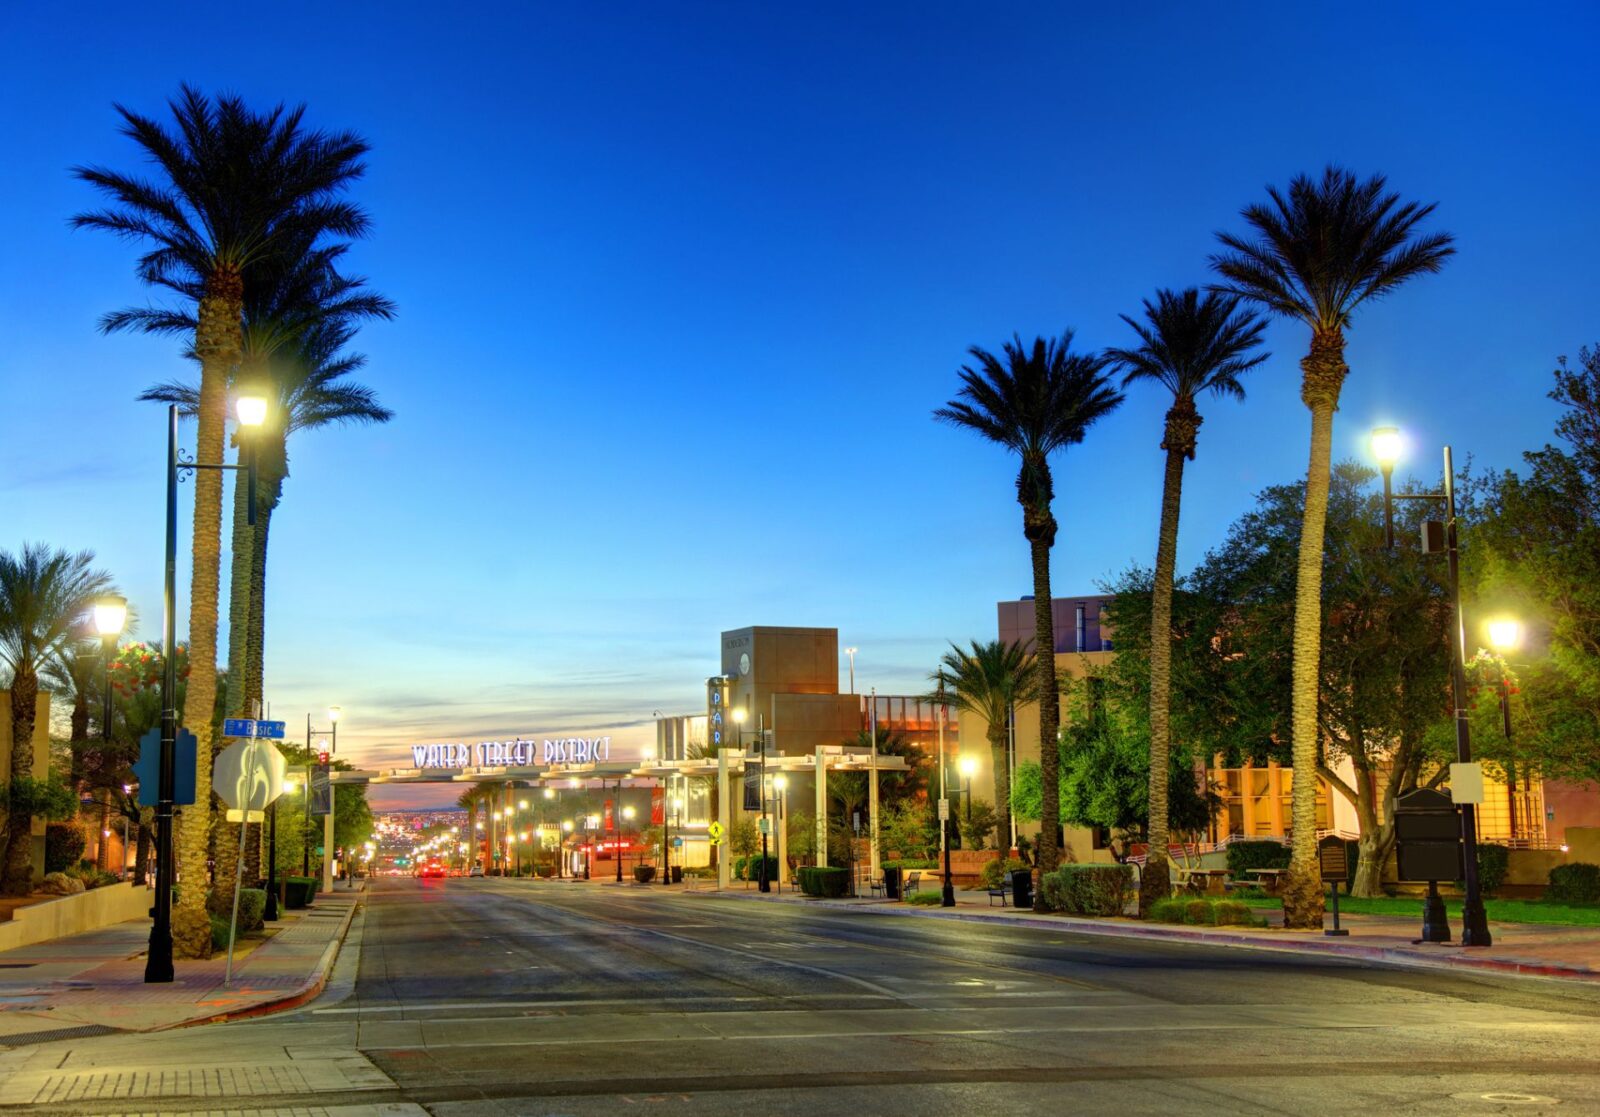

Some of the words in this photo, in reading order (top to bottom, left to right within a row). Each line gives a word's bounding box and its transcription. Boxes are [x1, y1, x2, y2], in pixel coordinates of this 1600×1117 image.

[246, 721, 273, 736] Basic
[412, 743, 470, 768] WATER
[476, 740, 535, 765] STREET
[544, 736, 611, 763] DISTRICT
